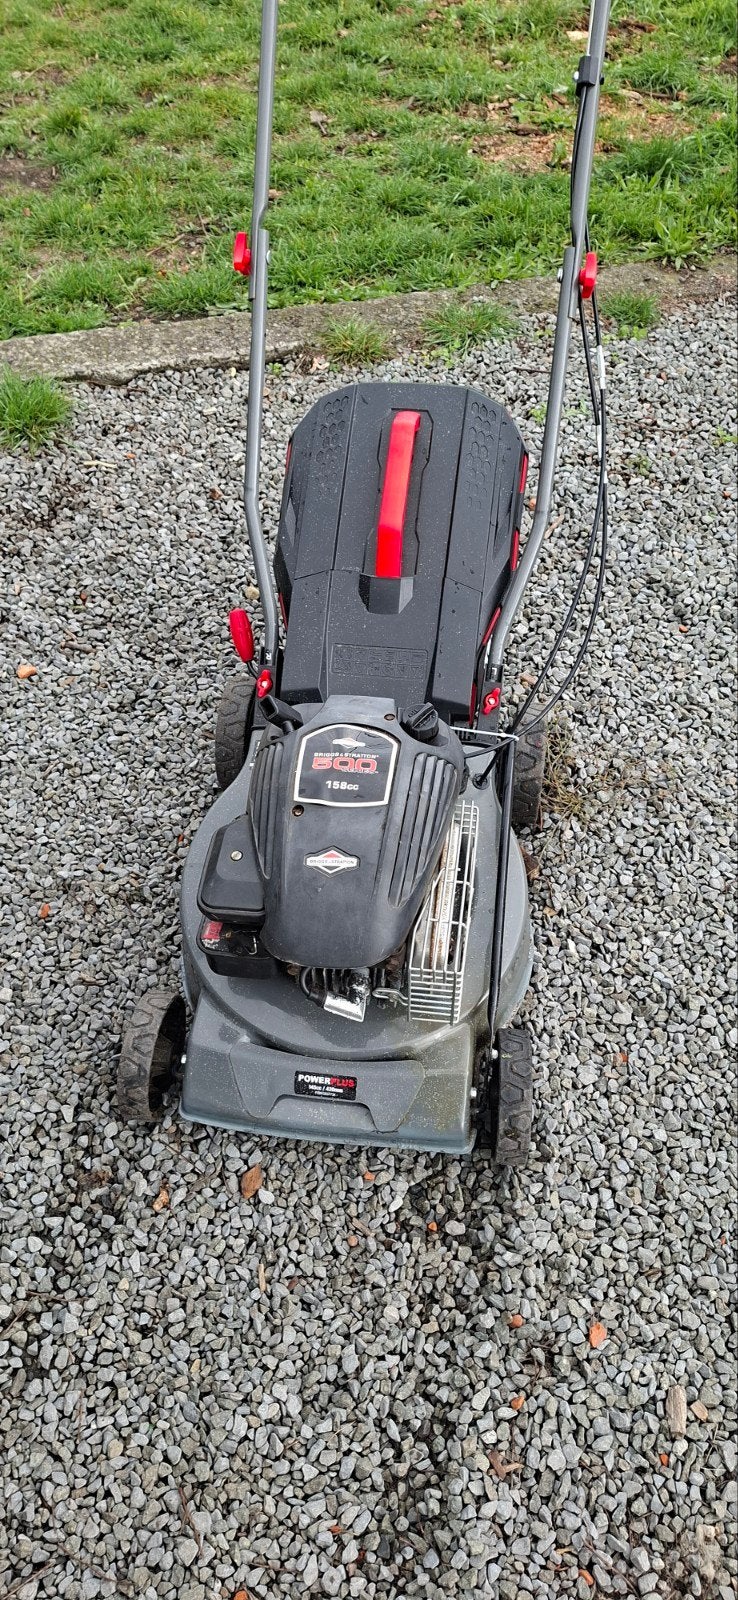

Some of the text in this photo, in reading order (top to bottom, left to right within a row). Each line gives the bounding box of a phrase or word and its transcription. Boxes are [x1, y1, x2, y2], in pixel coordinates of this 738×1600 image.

[311, 756, 378, 772] 500
[325, 780, 359, 791] 158cc
[298, 1074, 354, 1087] POWERPLUS
